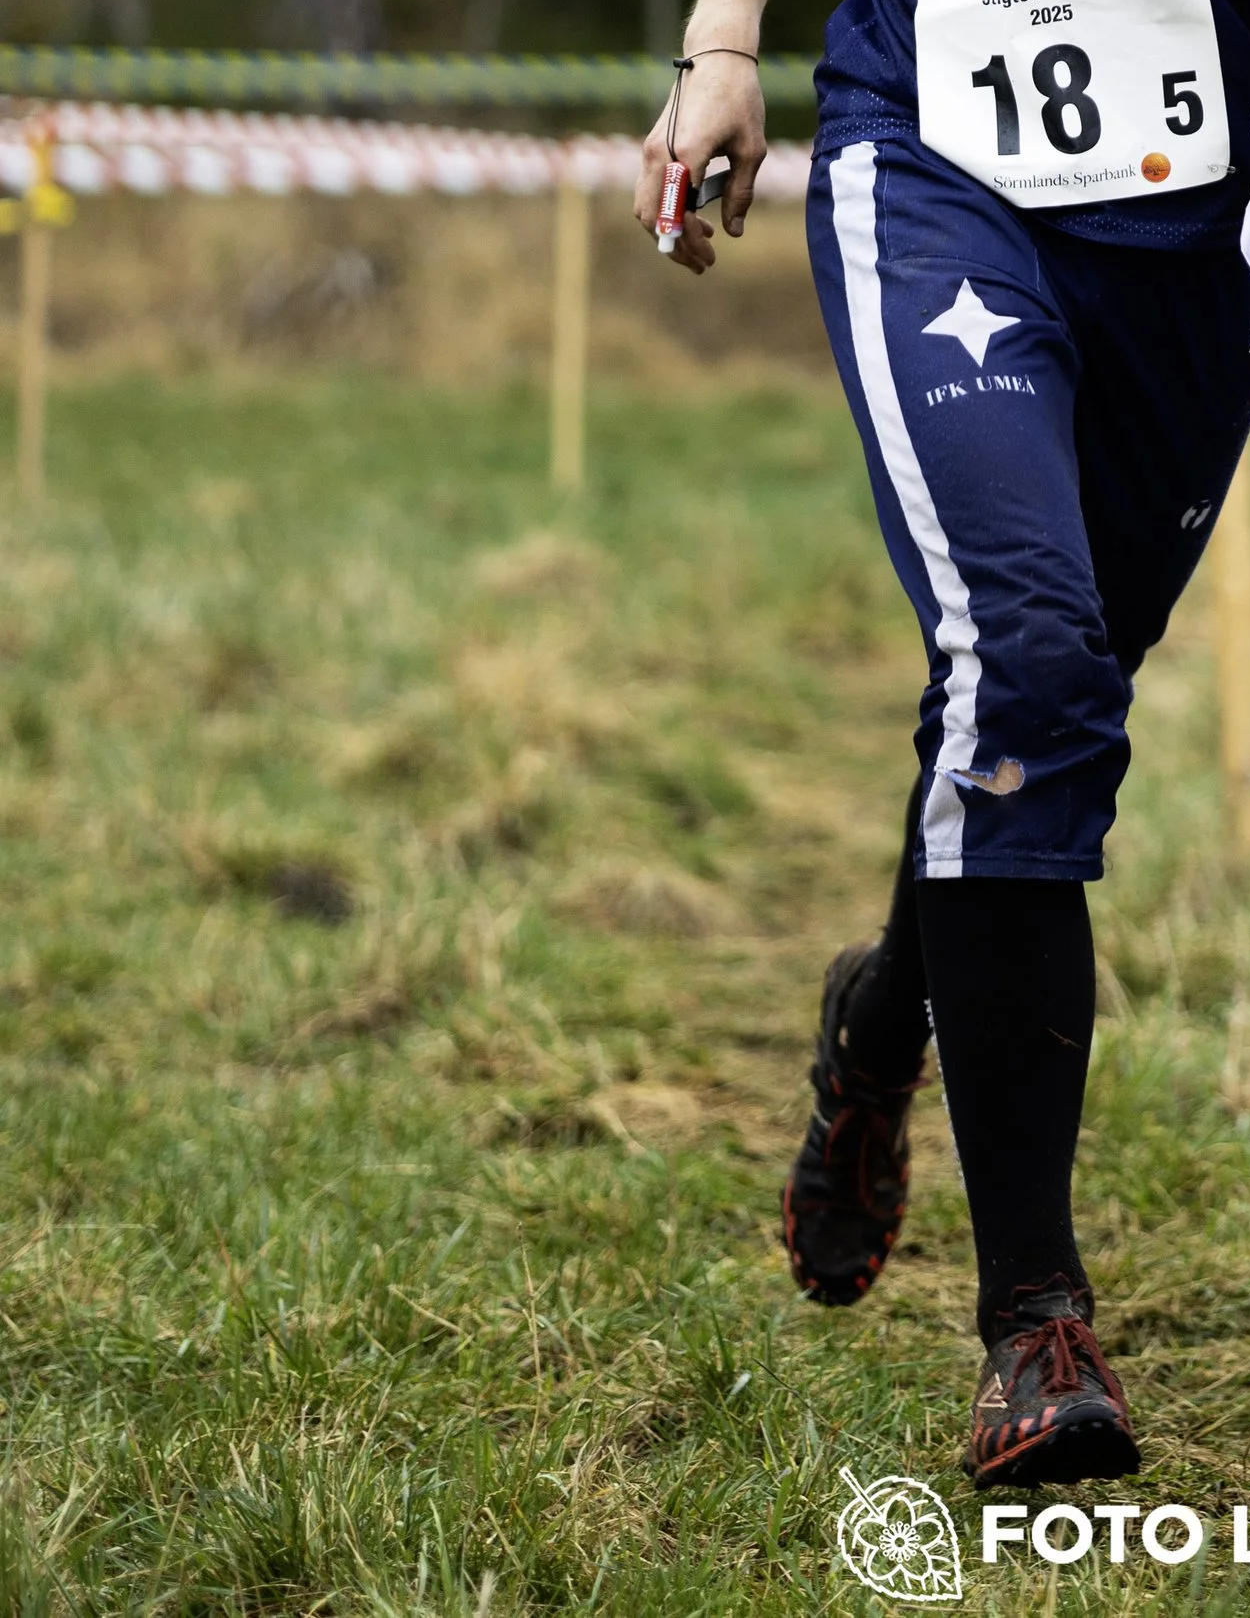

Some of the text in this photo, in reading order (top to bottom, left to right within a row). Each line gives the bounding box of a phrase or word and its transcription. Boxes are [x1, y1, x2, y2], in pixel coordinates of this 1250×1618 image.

[1030, 4, 1073, 26] 2025
[971, 43, 1102, 156] 18
[1161, 70, 1204, 136] 5
[993, 164, 1137, 190] Sörmlands Sparbank
[926, 373, 1036, 407] IFK UMEÅ
